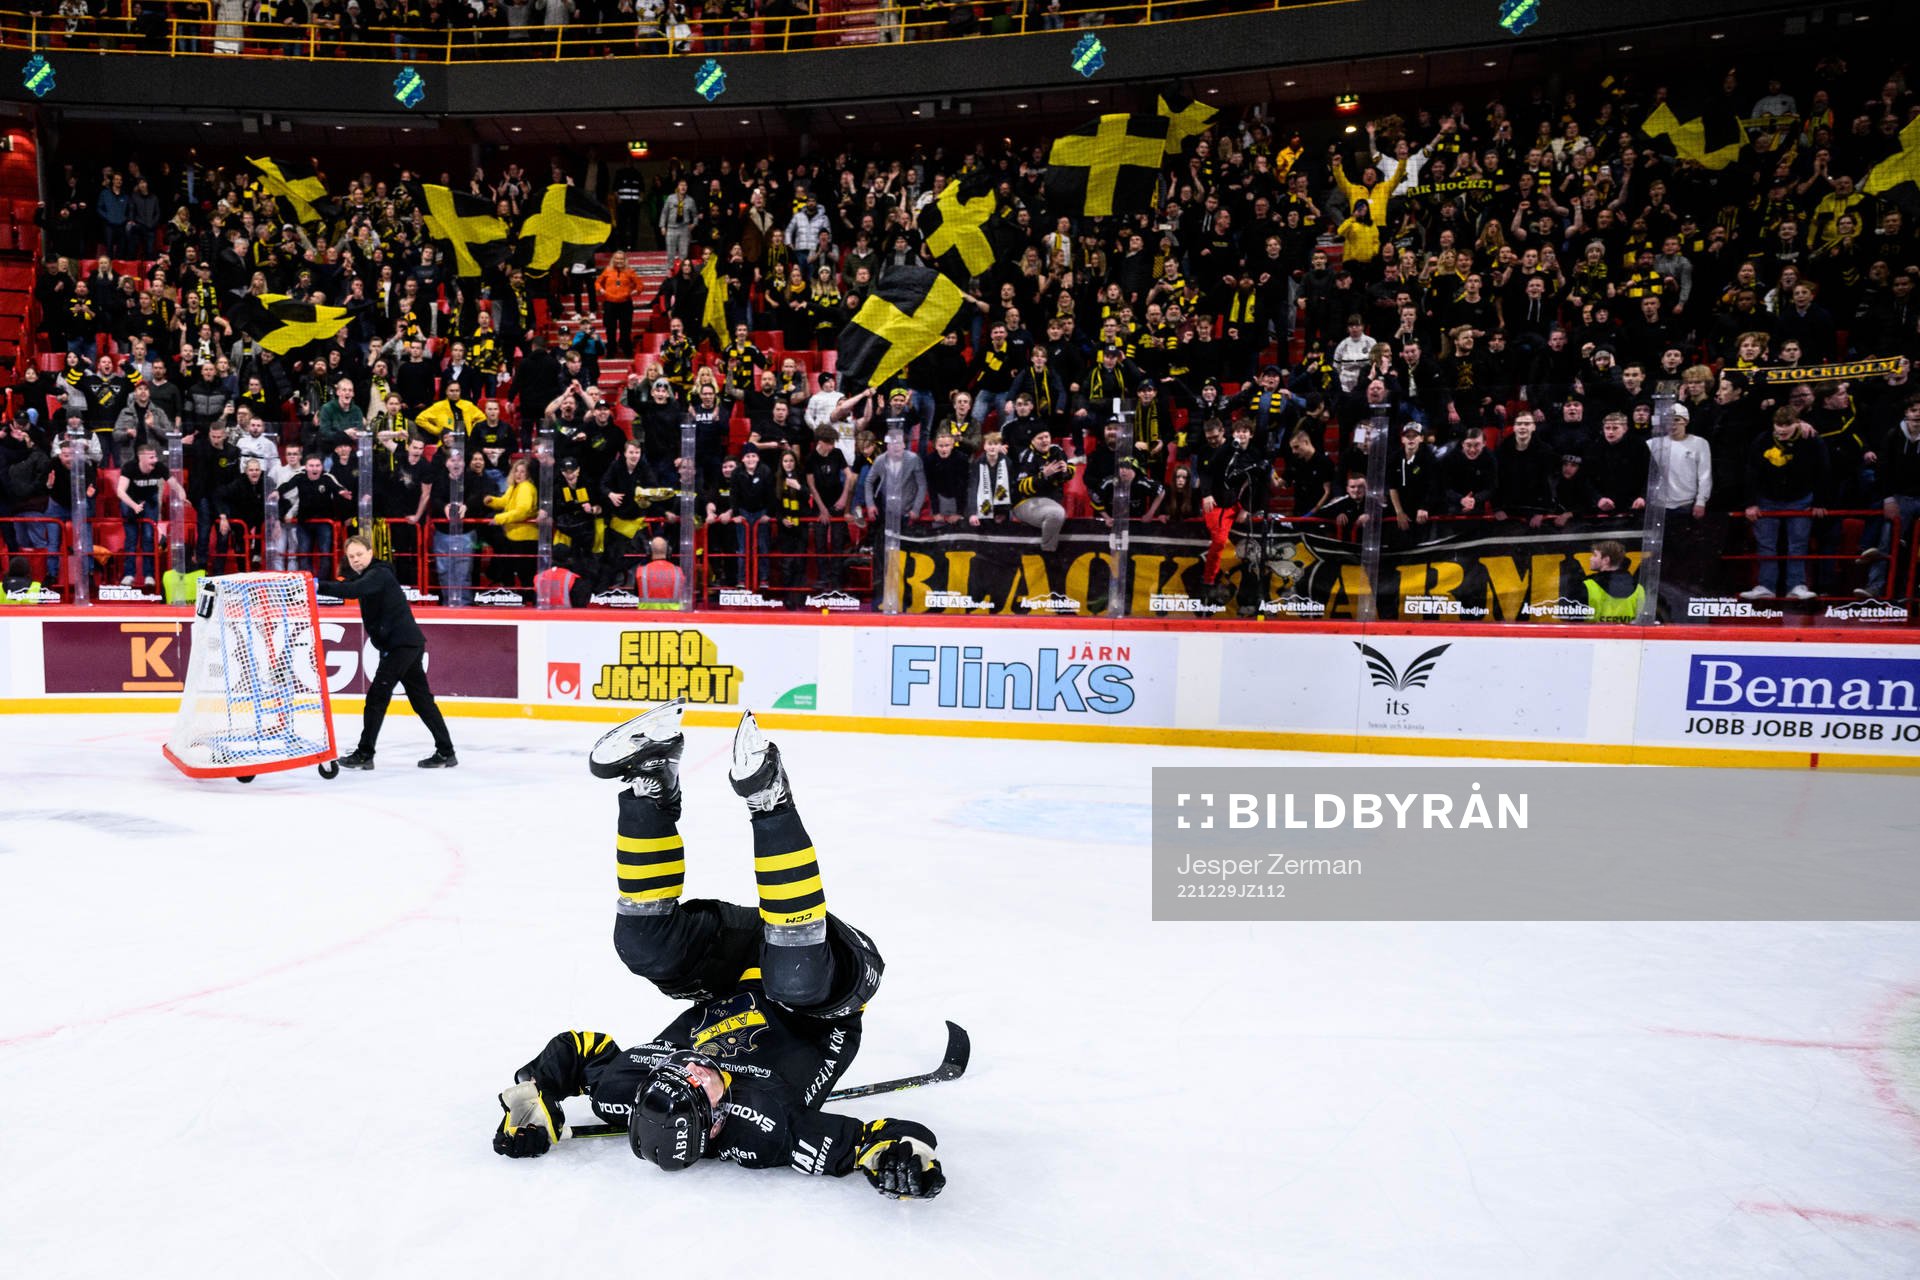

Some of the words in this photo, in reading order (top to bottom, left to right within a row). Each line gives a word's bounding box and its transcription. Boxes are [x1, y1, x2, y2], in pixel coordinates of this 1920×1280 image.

[1766, 360, 1895, 380] STOCKHOLM
[878, 551, 1200, 618] BLACK
[130, 637, 175, 678] K
[620, 630, 702, 666] EURO
[1068, 641, 1131, 661] JÄRN
[592, 664, 734, 703] JACKPOT
[891, 644, 1135, 714] Flinks
[1696, 660, 1920, 711] Beman
[1386, 698, 1410, 715] its
[1685, 717, 1745, 735] JOBB
[1752, 719, 1813, 738] JOBB
[1821, 722, 1884, 740] JOBB
[785, 912, 813, 924] CCM
[804, 1059, 837, 1106] JÄRFÄLA
[830, 1028, 847, 1053] KÖK
[598, 1101, 632, 1115] KODA
